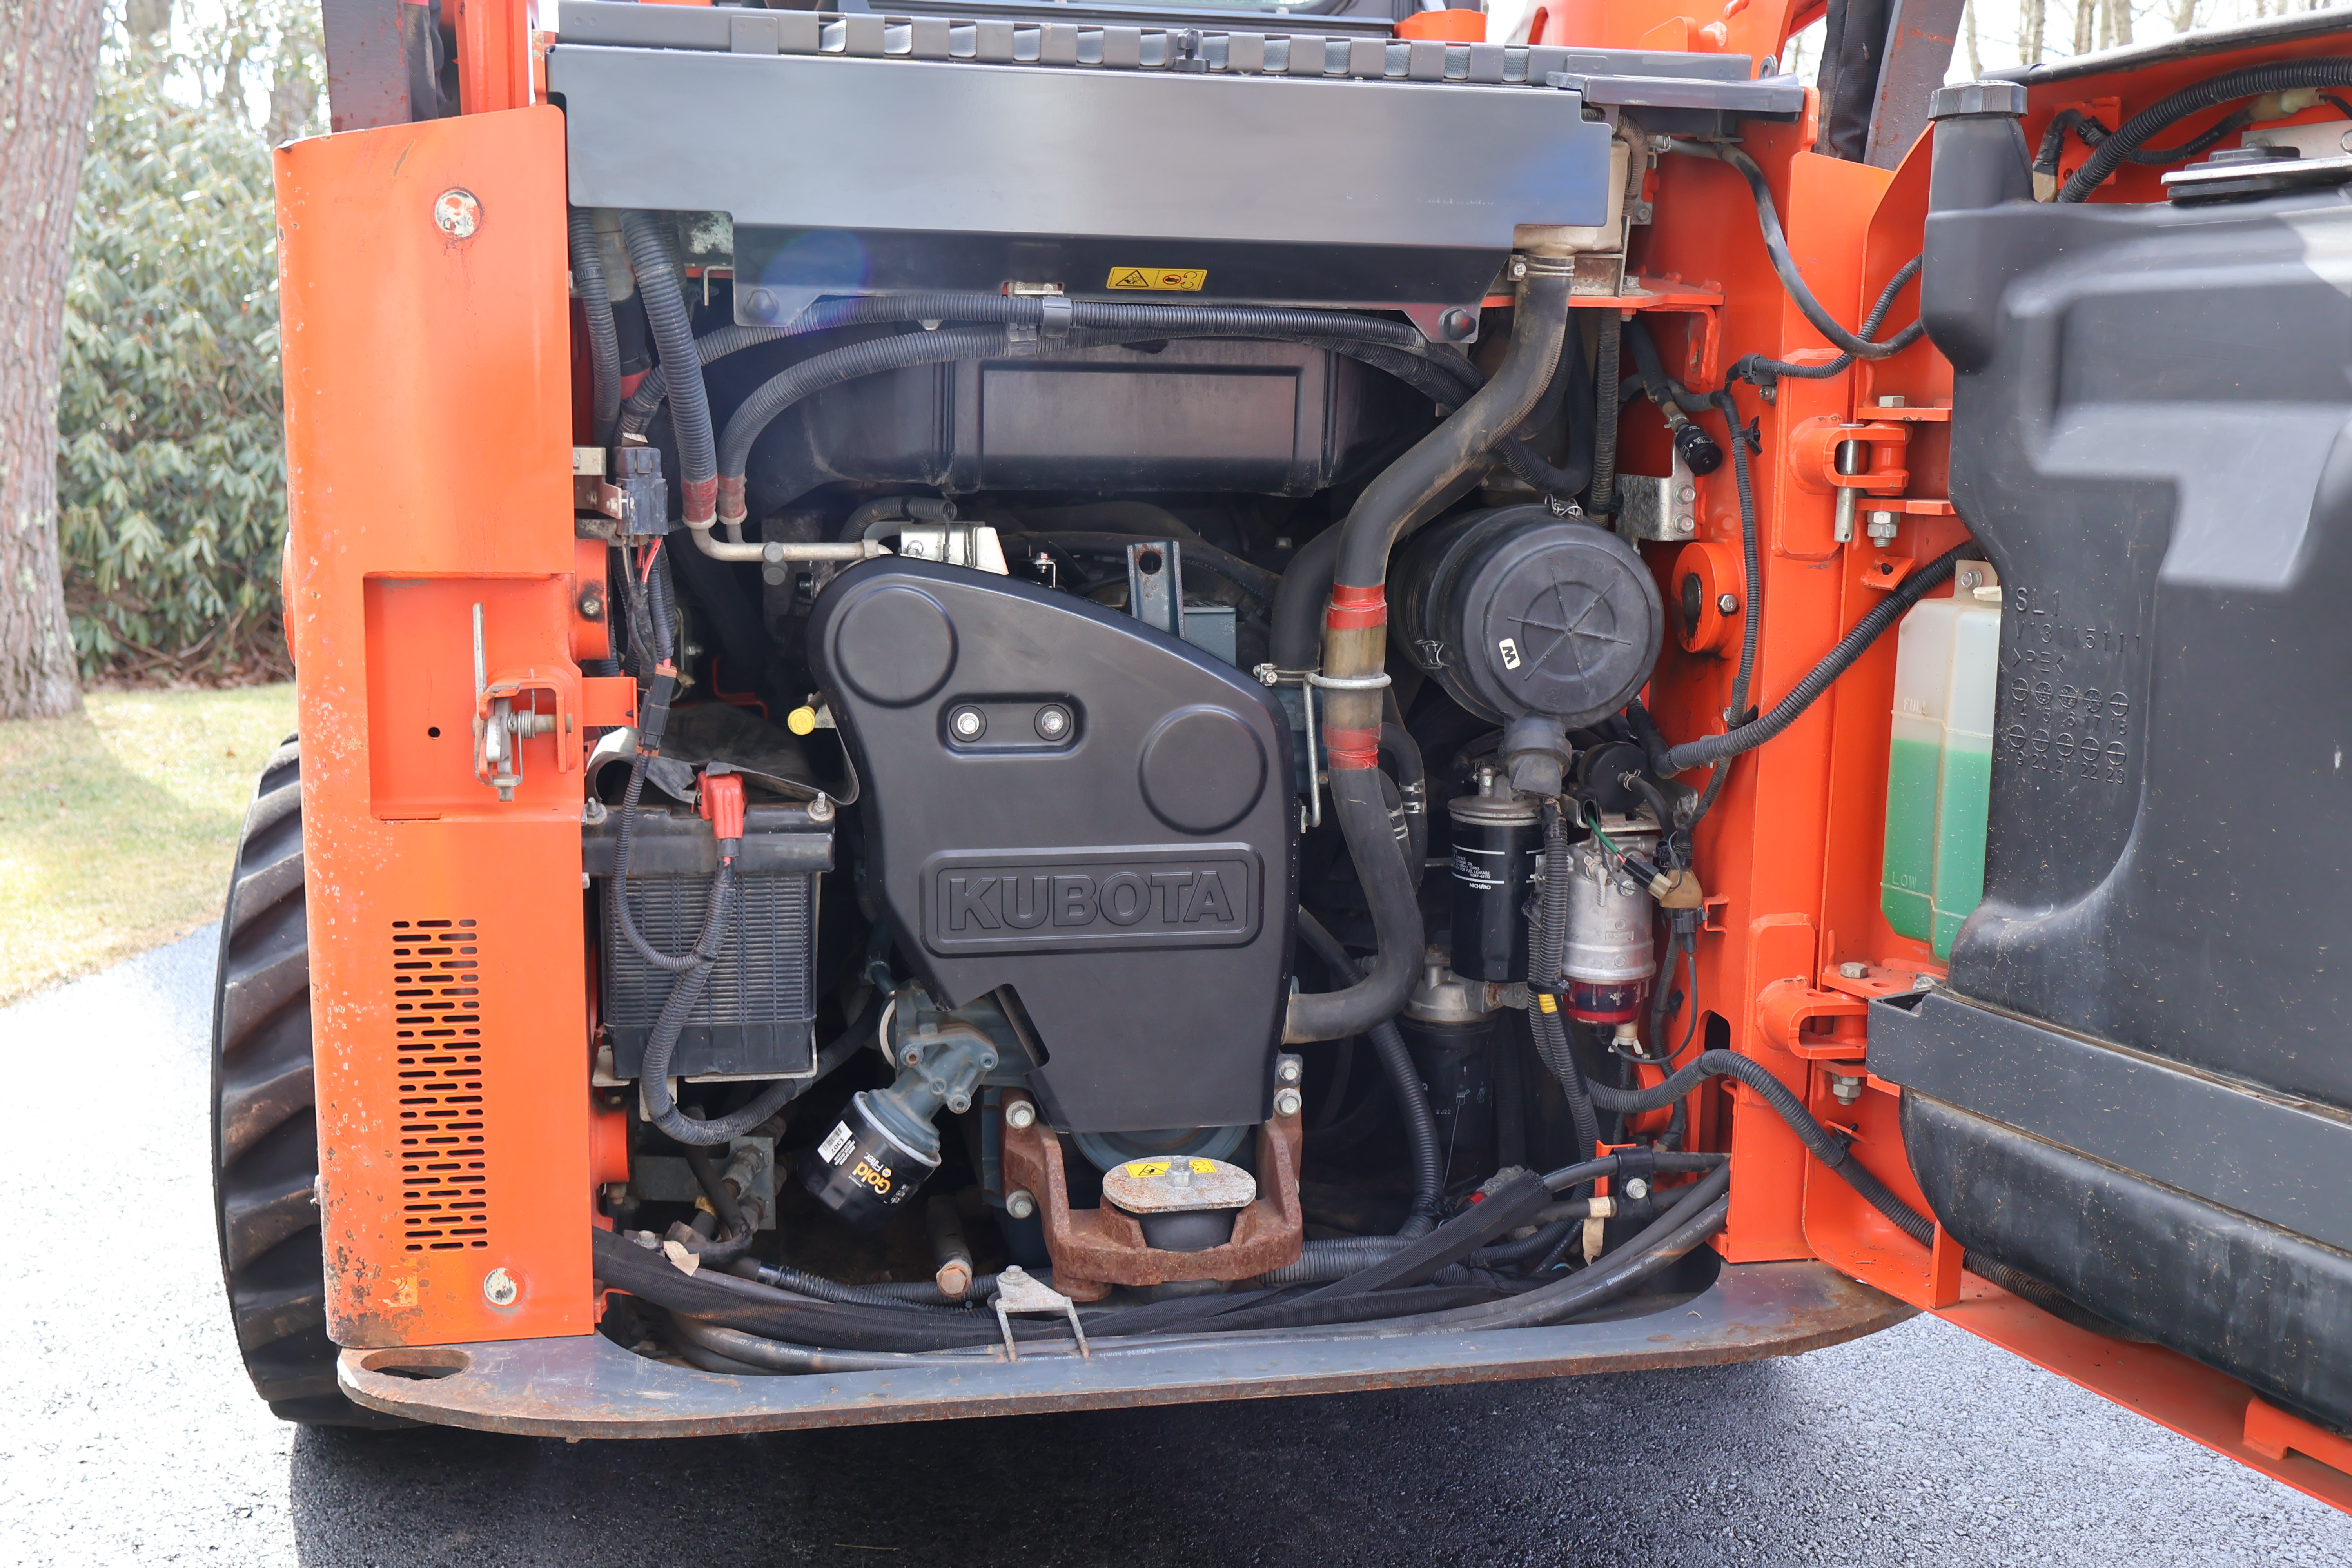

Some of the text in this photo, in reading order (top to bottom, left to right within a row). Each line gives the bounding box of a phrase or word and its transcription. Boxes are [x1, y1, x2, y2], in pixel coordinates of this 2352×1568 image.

[1568, 552, 1606, 576] TOP
[1904, 698, 1927, 715] FULL
[2085, 714, 2102, 731] 17
[2111, 718, 2127, 735] 18
[2031, 753, 2049, 770] 20
[2080, 762, 2098, 780] 22
[2105, 766, 2125, 784] 23
[1892, 871, 1916, 889] LOW
[949, 871, 1234, 931] KUBOTA
[831, 1138, 844, 1154] 1307
[852, 1161, 891, 1194] Gold
[1607, 1263, 1642, 1286] BRIDGESTONE
[780, 1347, 808, 1357] 24.5MPa
